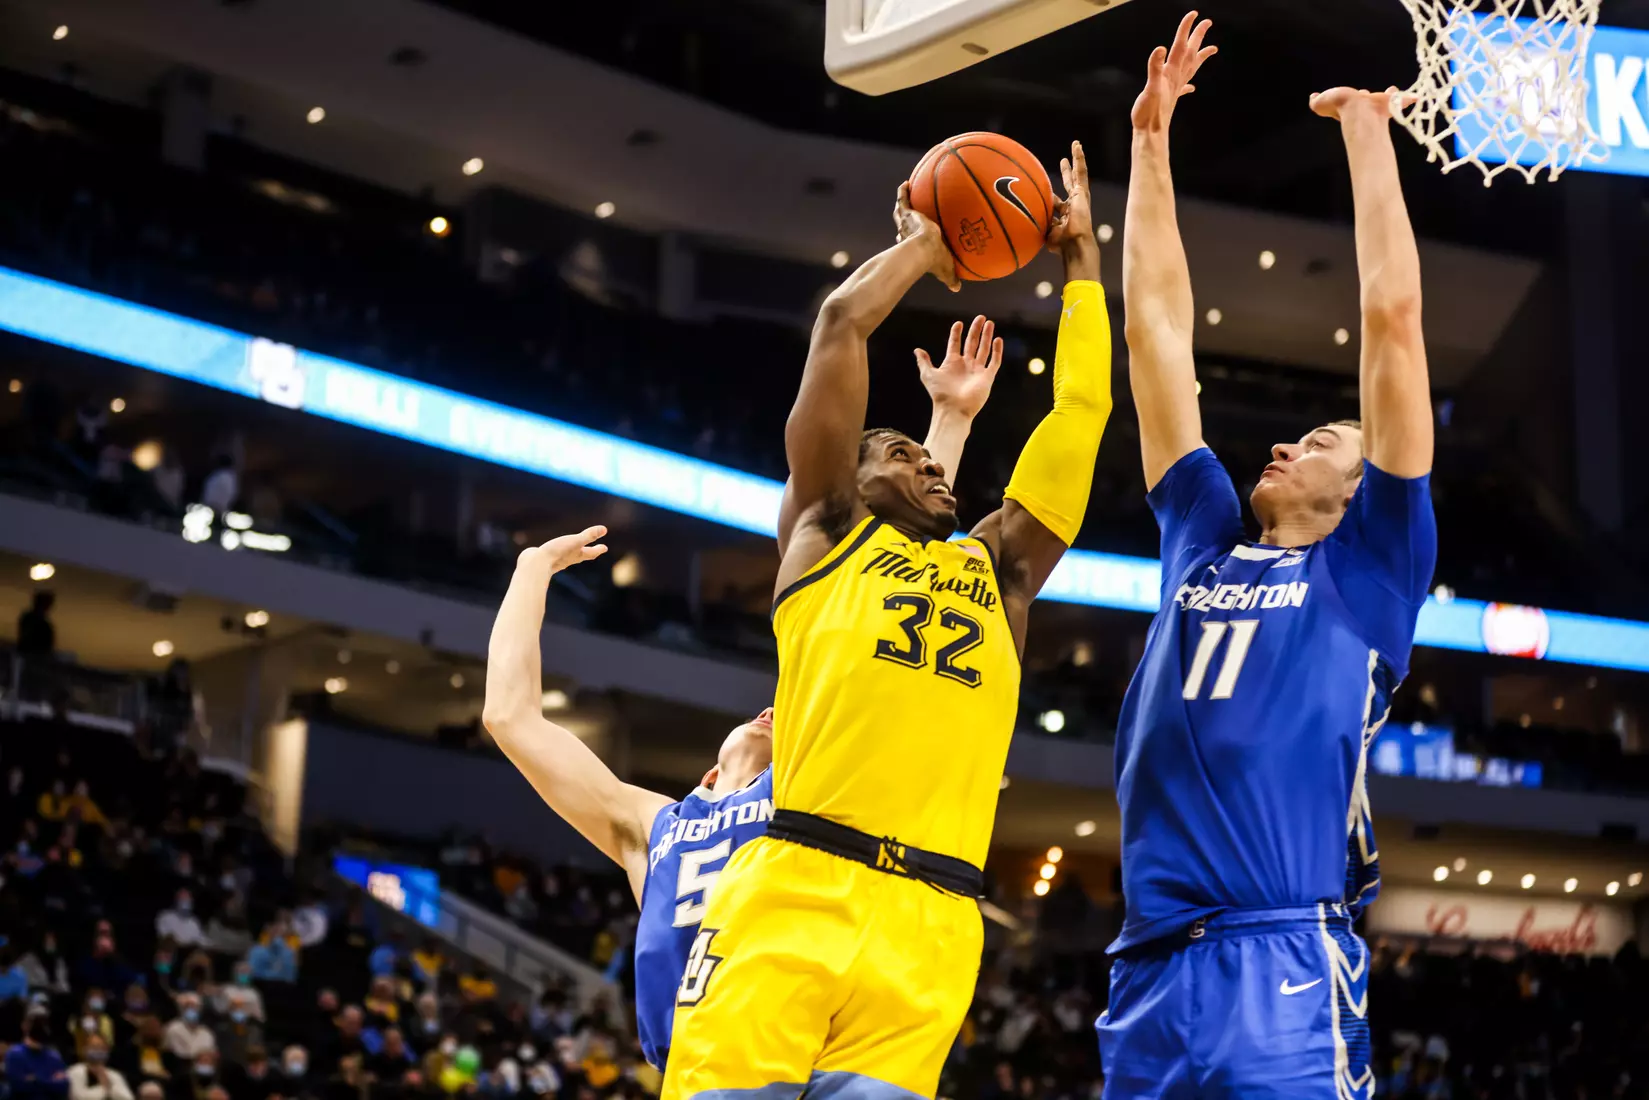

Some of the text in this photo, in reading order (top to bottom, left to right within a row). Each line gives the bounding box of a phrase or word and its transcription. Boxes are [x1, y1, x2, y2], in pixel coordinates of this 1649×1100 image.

[1594, 52, 1649, 149] K
[963, 563, 989, 575] EAST
[966, 557, 985, 567] BIG
[872, 592, 983, 688] 32
[1182, 619, 1260, 700] 11
[671, 838, 732, 928] 5
